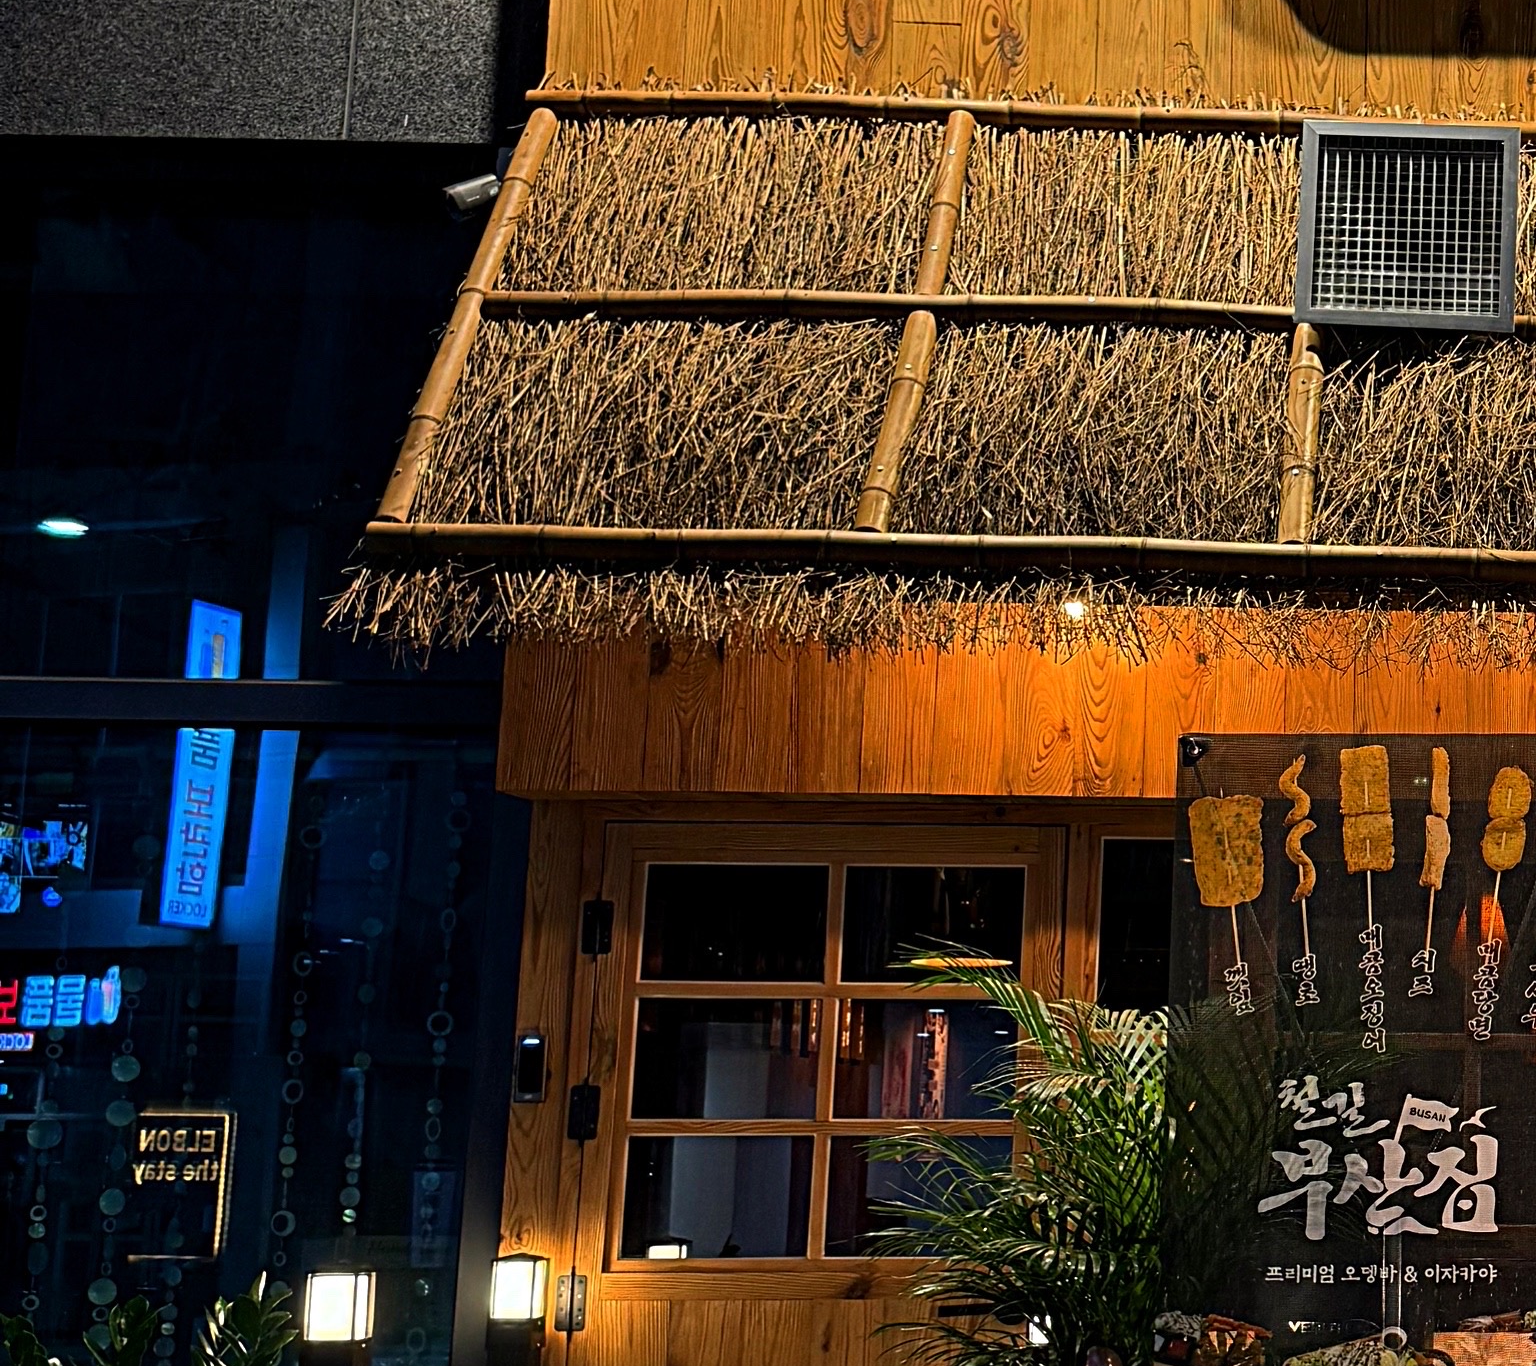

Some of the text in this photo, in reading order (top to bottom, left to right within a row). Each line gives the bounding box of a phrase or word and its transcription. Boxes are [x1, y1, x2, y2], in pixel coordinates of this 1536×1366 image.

[1225, 961, 1255, 1015] 깻잎
[1293, 954, 1320, 1006] 땡초
[1359, 924, 1386, 1053] 매콤오징어
[1408, 949, 1437, 997] 치즈
[1469, 938, 1502, 1041] 매콤당면
[1279, 1075, 1390, 1138] 철길
[1408, 1106, 1448, 1124] BUSAN
[1258, 1135, 1500, 1240] 부산집
[1264, 1264, 1499, 1286] 프리미엄 오뎅바 & 이자카야
